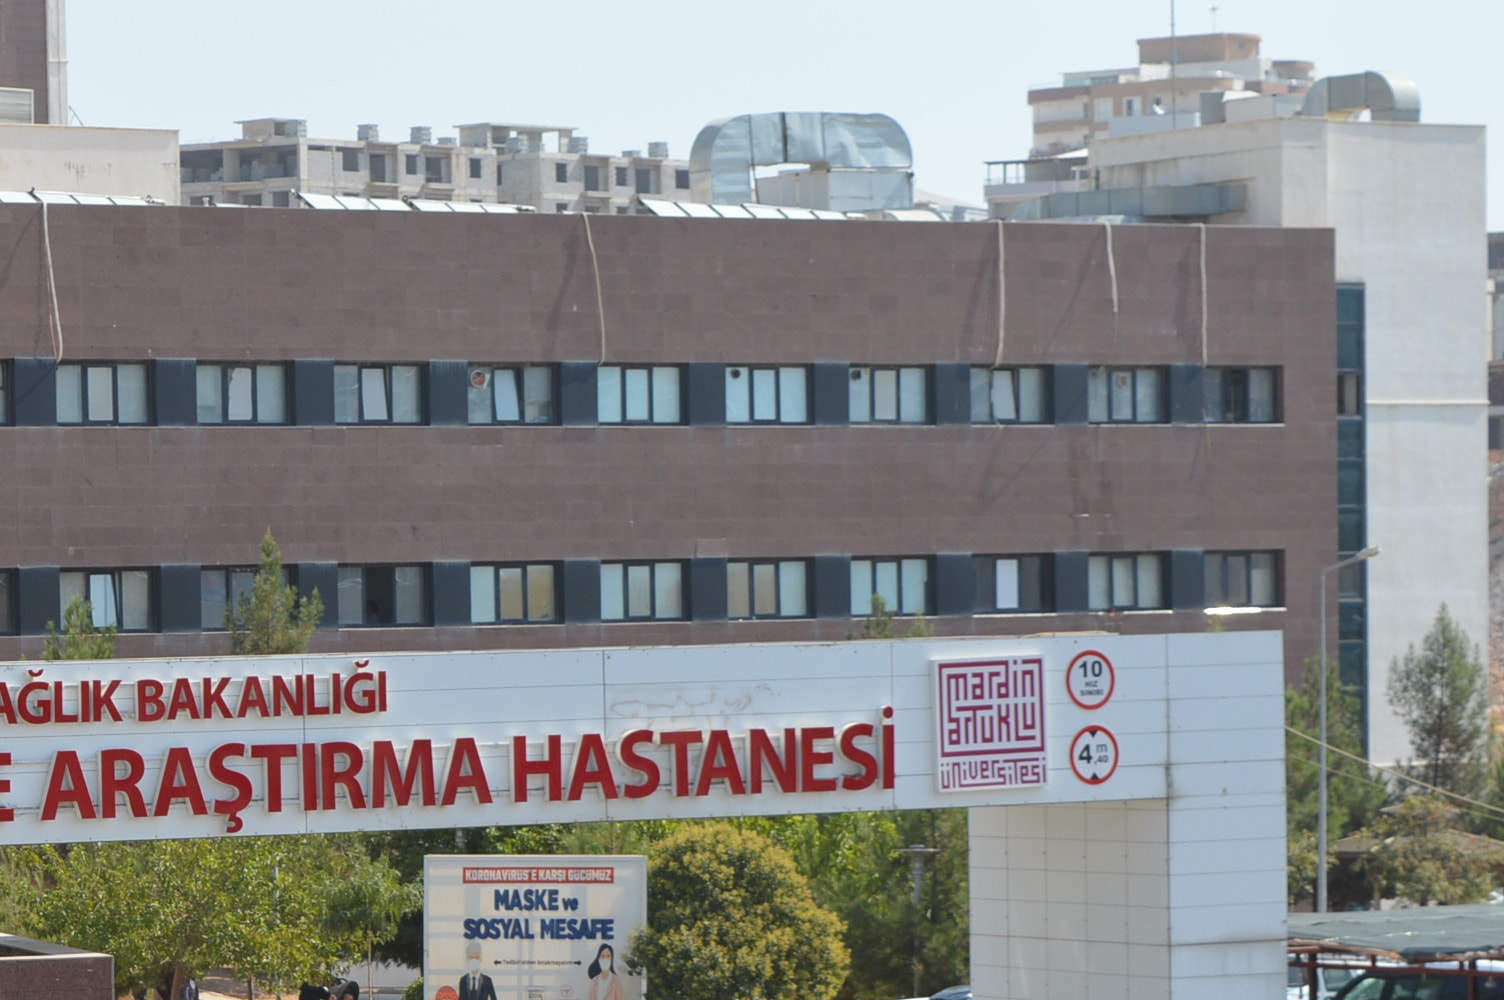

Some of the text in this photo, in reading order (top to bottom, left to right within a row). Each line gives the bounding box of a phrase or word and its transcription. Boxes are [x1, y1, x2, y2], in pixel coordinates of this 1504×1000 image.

[1078, 659, 1103, 679] 10
[137, 659, 389, 723] BAKANLIĞI
[41, 736, 494, 834] ARAŞTIRMA
[512, 705, 896, 804] HASTANESİ
[538, 867, 566, 882] KARŞI
[494, 889, 579, 911] MASKE ve
[463, 918, 615, 940] SOSYAL MESAFE
